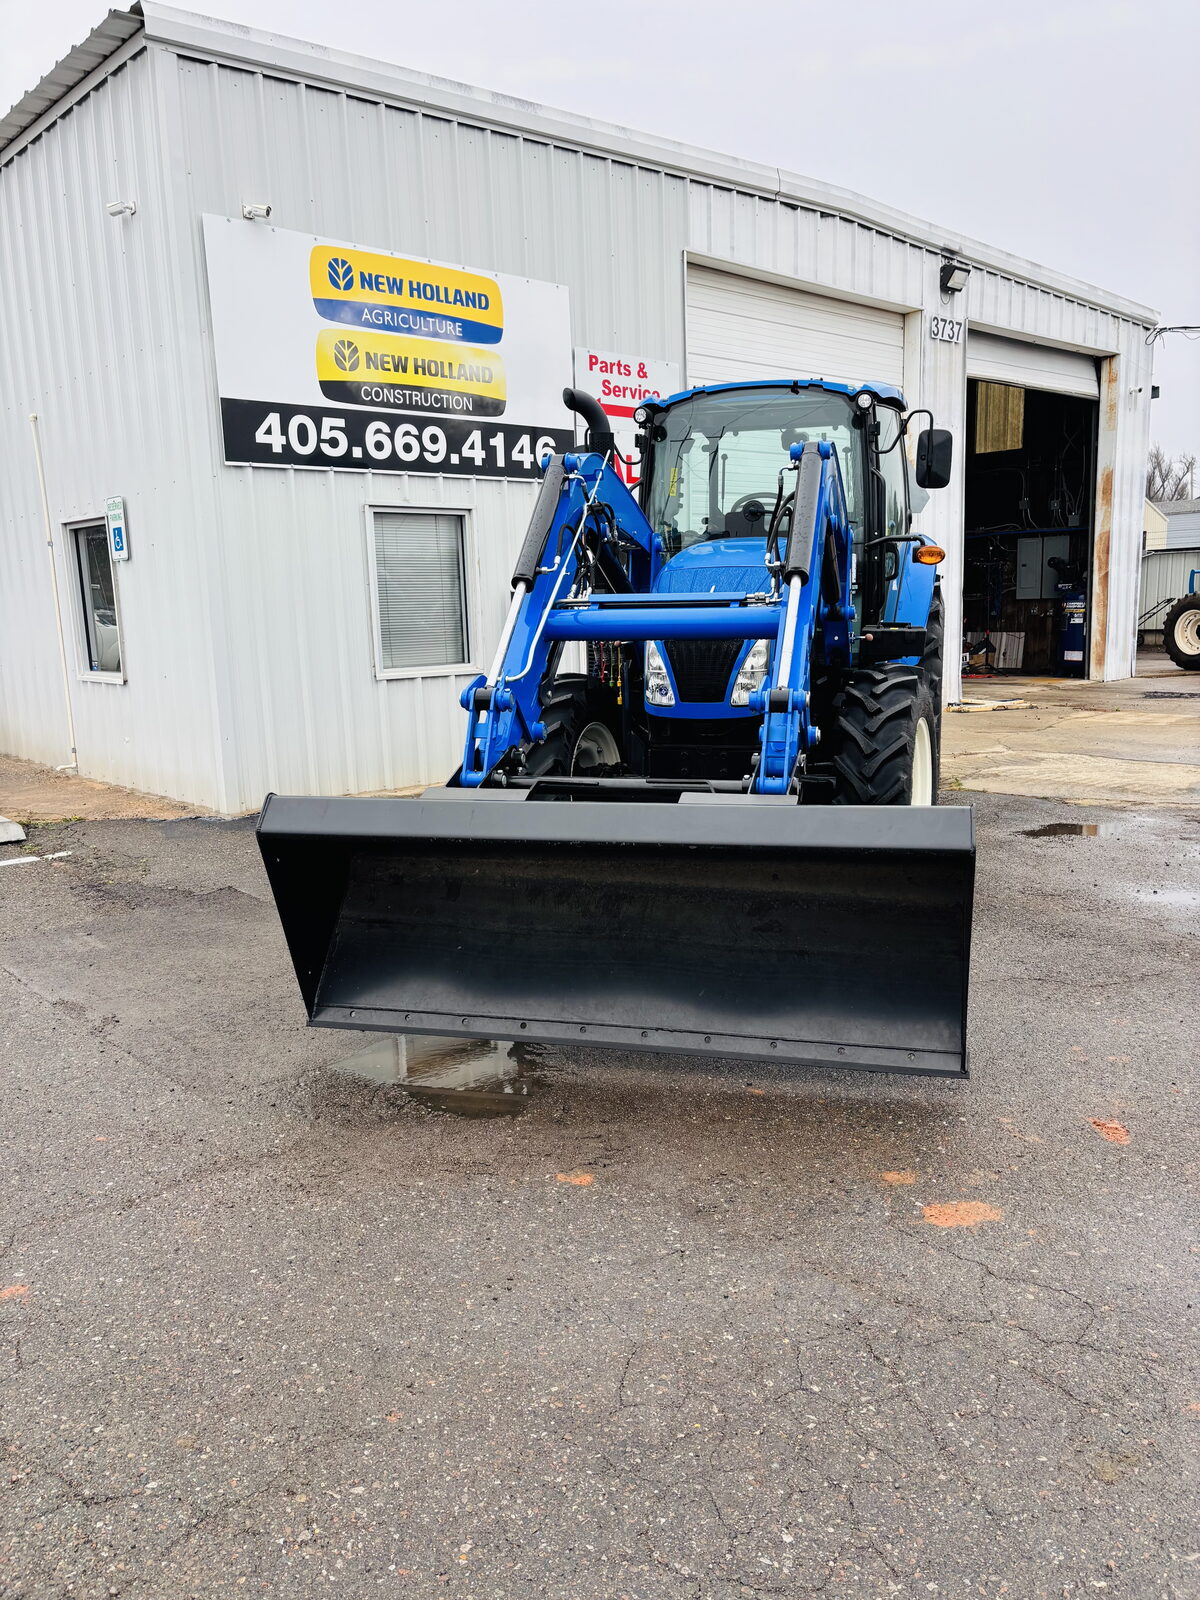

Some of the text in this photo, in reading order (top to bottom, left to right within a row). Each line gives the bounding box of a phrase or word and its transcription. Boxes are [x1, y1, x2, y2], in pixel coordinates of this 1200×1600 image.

[359, 271, 489, 311] NEW HOLLAND
[361, 308, 463, 337] AGRICULTURE
[932, 317, 962, 341] 3737
[365, 351, 494, 384] NEW HOLLAND
[588, 354, 648, 379] Parts &
[361, 386, 473, 411] CONSTRUCTION
